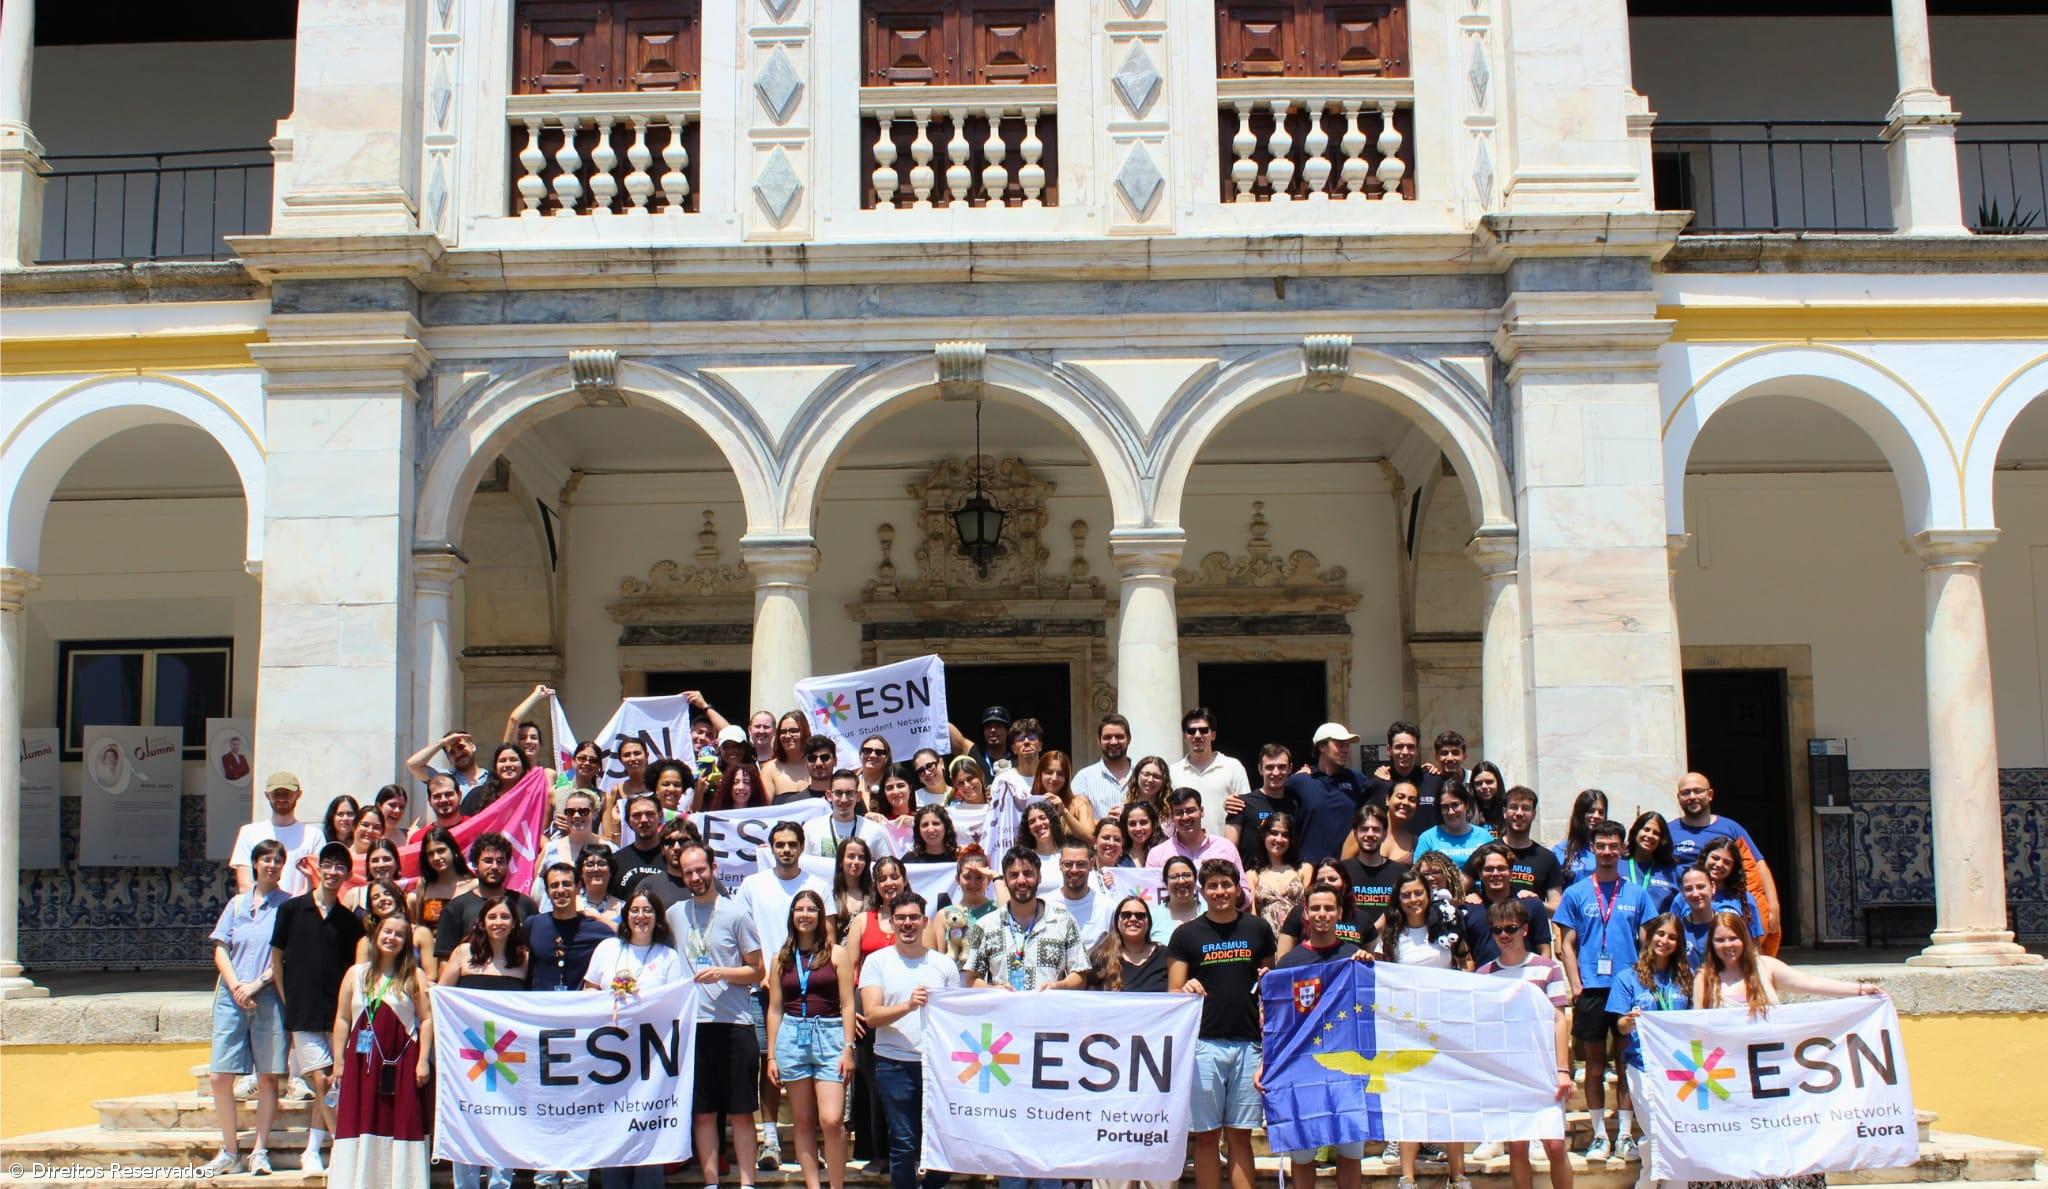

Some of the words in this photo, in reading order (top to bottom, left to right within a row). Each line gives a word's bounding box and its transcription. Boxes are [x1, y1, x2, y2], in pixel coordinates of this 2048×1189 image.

[855, 676, 930, 719] ESN
[859, 722, 893, 736] Student
[897, 716, 931, 727] Networ
[20, 738, 52, 763] lumni
[703, 814, 768, 862] ES
[1353, 885, 1393, 895] RASMUS
[1202, 940, 1249, 953] ERASMUS
[1204, 948, 1252, 961] ADDICTED
[539, 1019, 680, 1086] ESN
[1032, 1032, 1174, 1093] ESN
[1747, 1029, 1898, 1099] ESN
[459, 1100, 527, 1116] Erasmus
[536, 1102, 605, 1116] Student
[614, 1094, 680, 1113] Network
[949, 1102, 1017, 1119] Erasmus
[1026, 1106, 1092, 1122] Student
[1100, 1108, 1169, 1124] Network
[628, 1116, 679, 1132] Aveiro
[1674, 1120, 1742, 1134] Erasmus
[1750, 1112, 1822, 1131] Student
[1829, 1102, 1903, 1122] Network
[1097, 1128, 1169, 1147] Portugal
[1856, 1121, 1905, 1139] Évora
